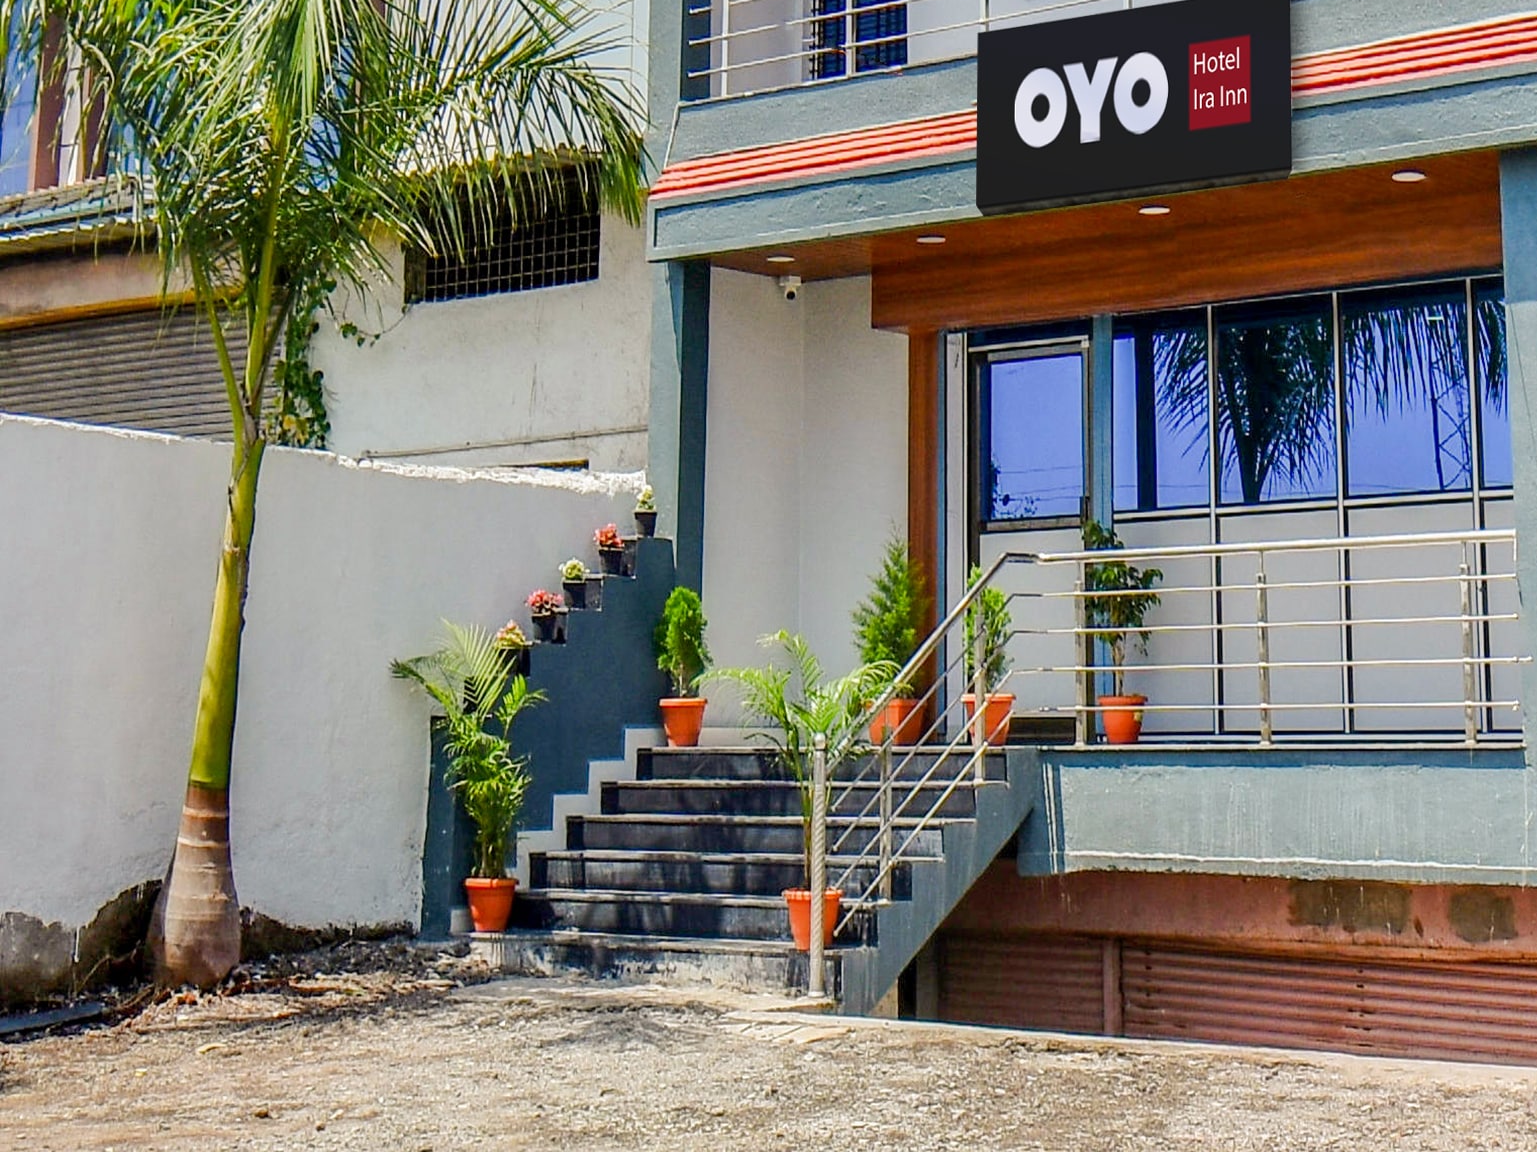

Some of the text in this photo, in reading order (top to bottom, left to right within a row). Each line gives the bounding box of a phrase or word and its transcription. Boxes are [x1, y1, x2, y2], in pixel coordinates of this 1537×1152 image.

[1193, 46, 1241, 75] Hotel
[1014, 51, 1169, 148] OYO
[1193, 85, 1248, 110] Ira Inn
